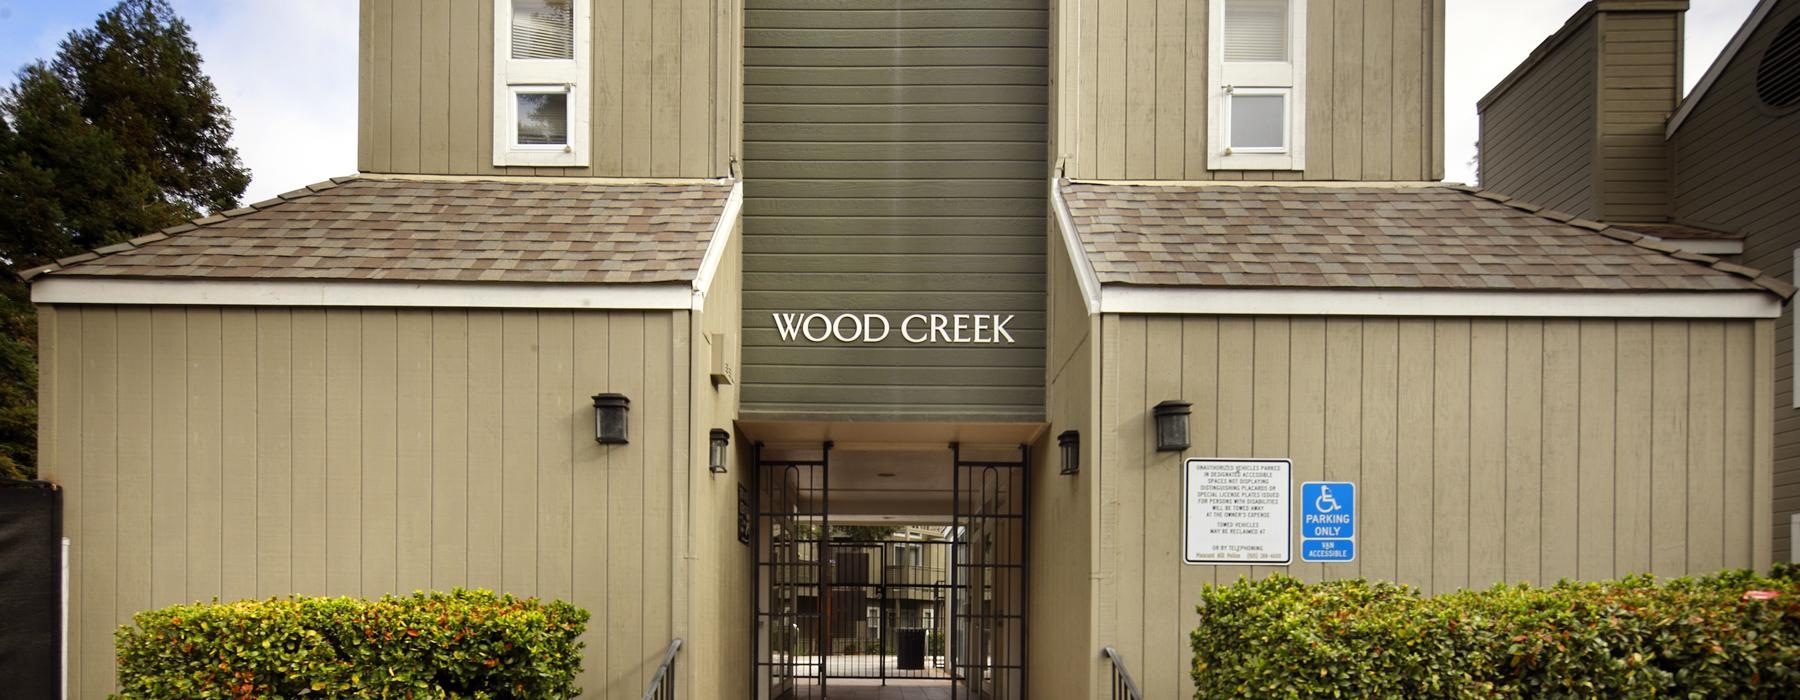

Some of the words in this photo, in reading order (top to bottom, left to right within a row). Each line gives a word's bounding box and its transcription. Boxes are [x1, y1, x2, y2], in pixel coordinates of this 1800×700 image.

[772, 313, 890, 343] WOOD
[900, 313, 1016, 343] CREEK
[1306, 514, 1350, 524] PARKING
[1314, 527, 1341, 536] ONLY
